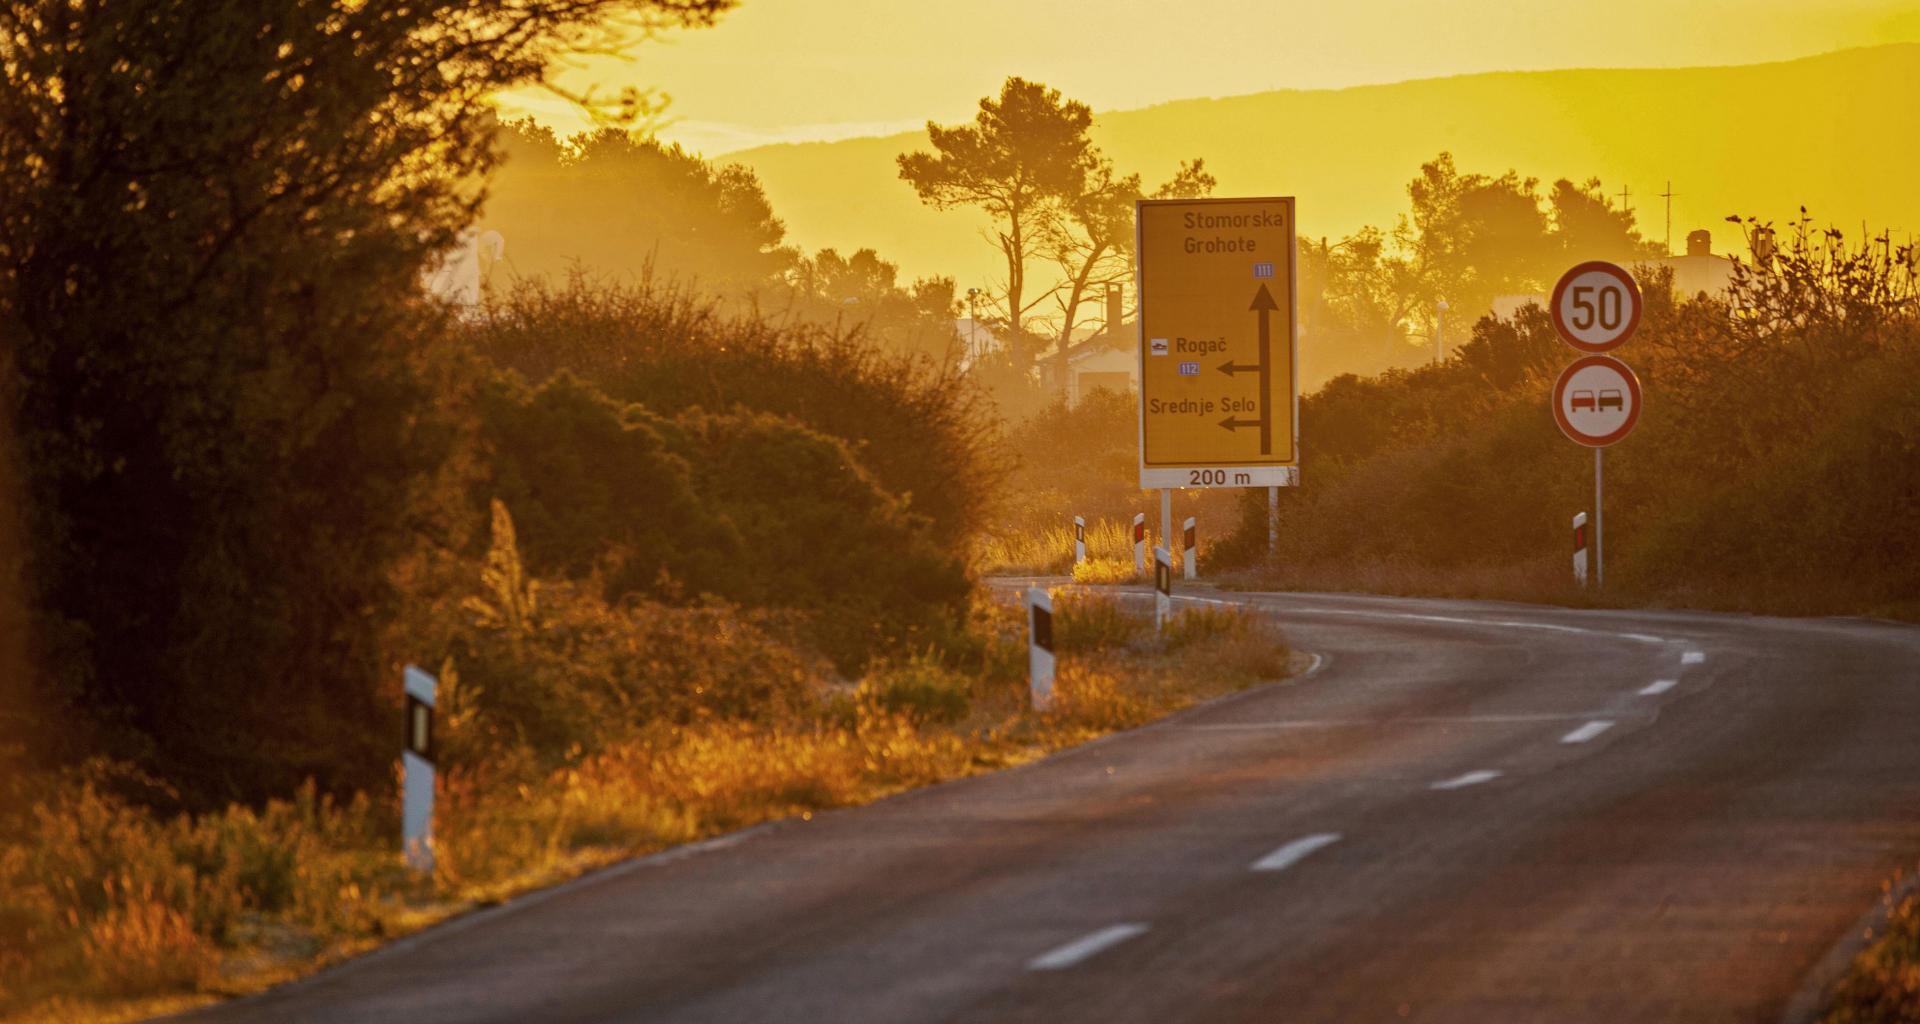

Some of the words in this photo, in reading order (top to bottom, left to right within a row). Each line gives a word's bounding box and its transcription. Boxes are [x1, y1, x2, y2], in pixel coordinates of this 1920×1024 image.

[1184, 210, 1283, 229] Stomorska
[1184, 236, 1256, 254] Grohote
[1257, 265, 1271, 277] 111
[1572, 286, 1622, 331] 50
[1176, 336, 1227, 356] Rogač
[1182, 364, 1197, 375] 112
[1150, 398, 1214, 417] Srednje
[1221, 397, 1256, 413] Selo
[1190, 470, 1226, 485] 200
[1235, 472, 1251, 485] m
